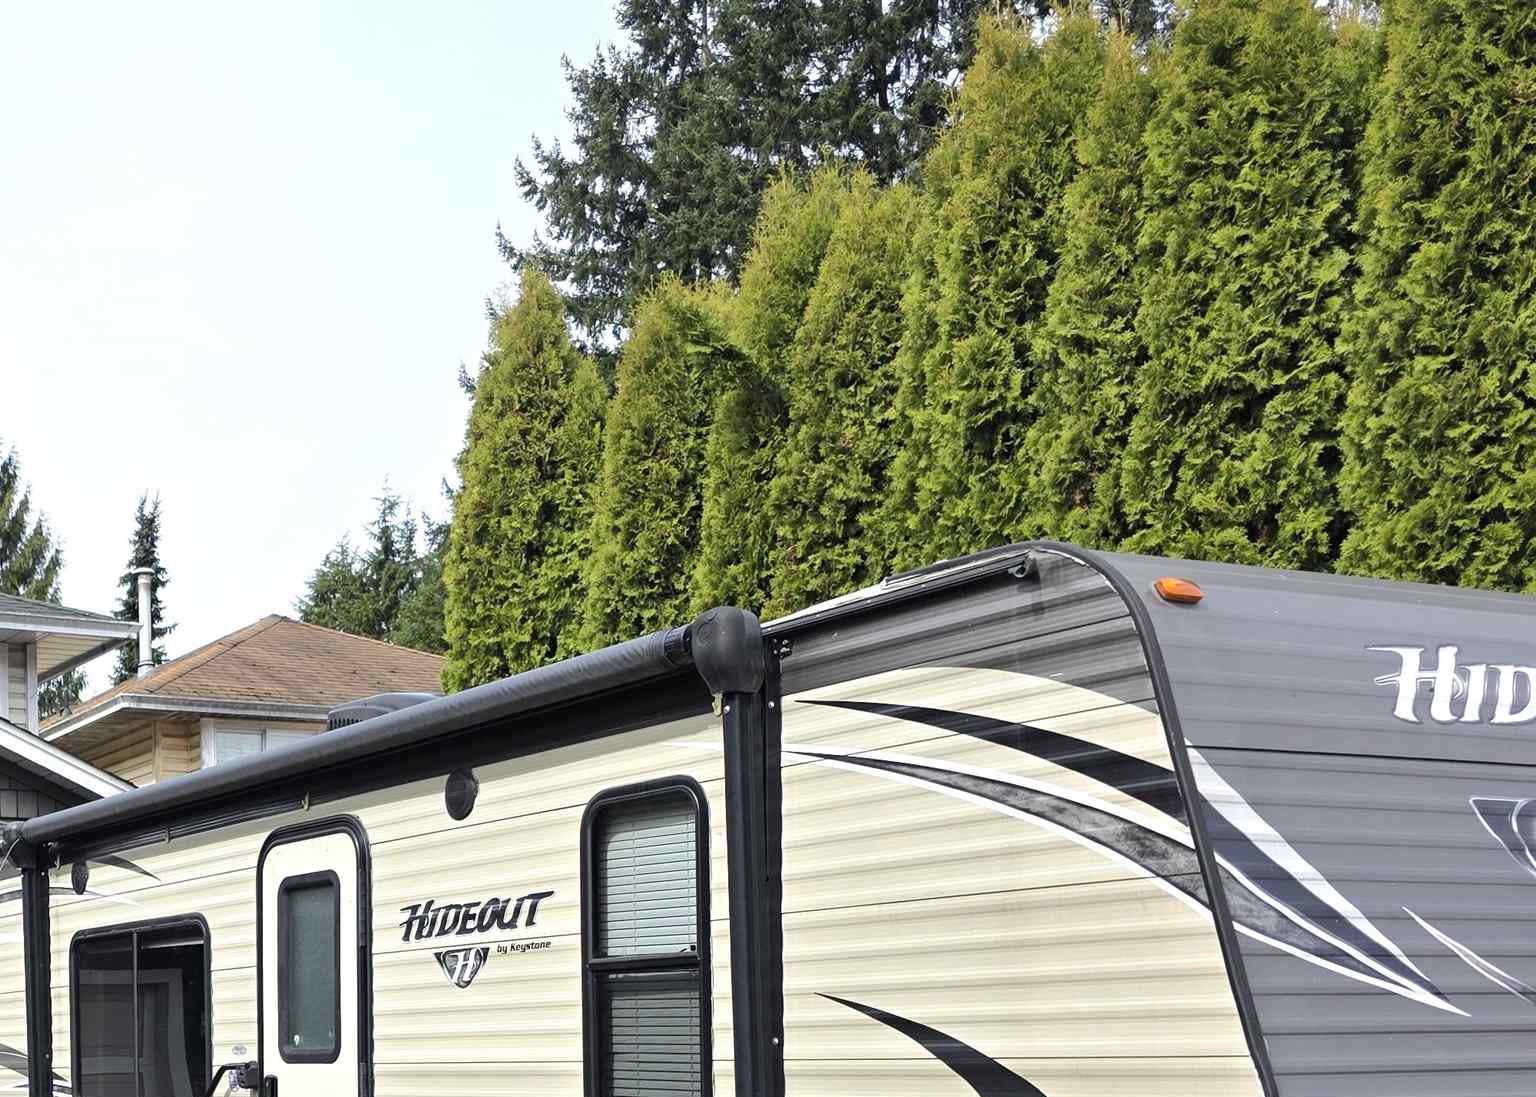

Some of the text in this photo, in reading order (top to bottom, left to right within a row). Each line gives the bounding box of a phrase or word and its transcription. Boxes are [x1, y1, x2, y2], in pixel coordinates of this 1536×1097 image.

[400, 890, 554, 942] HIDEOUT
[497, 941, 552, 955] by Keystone
